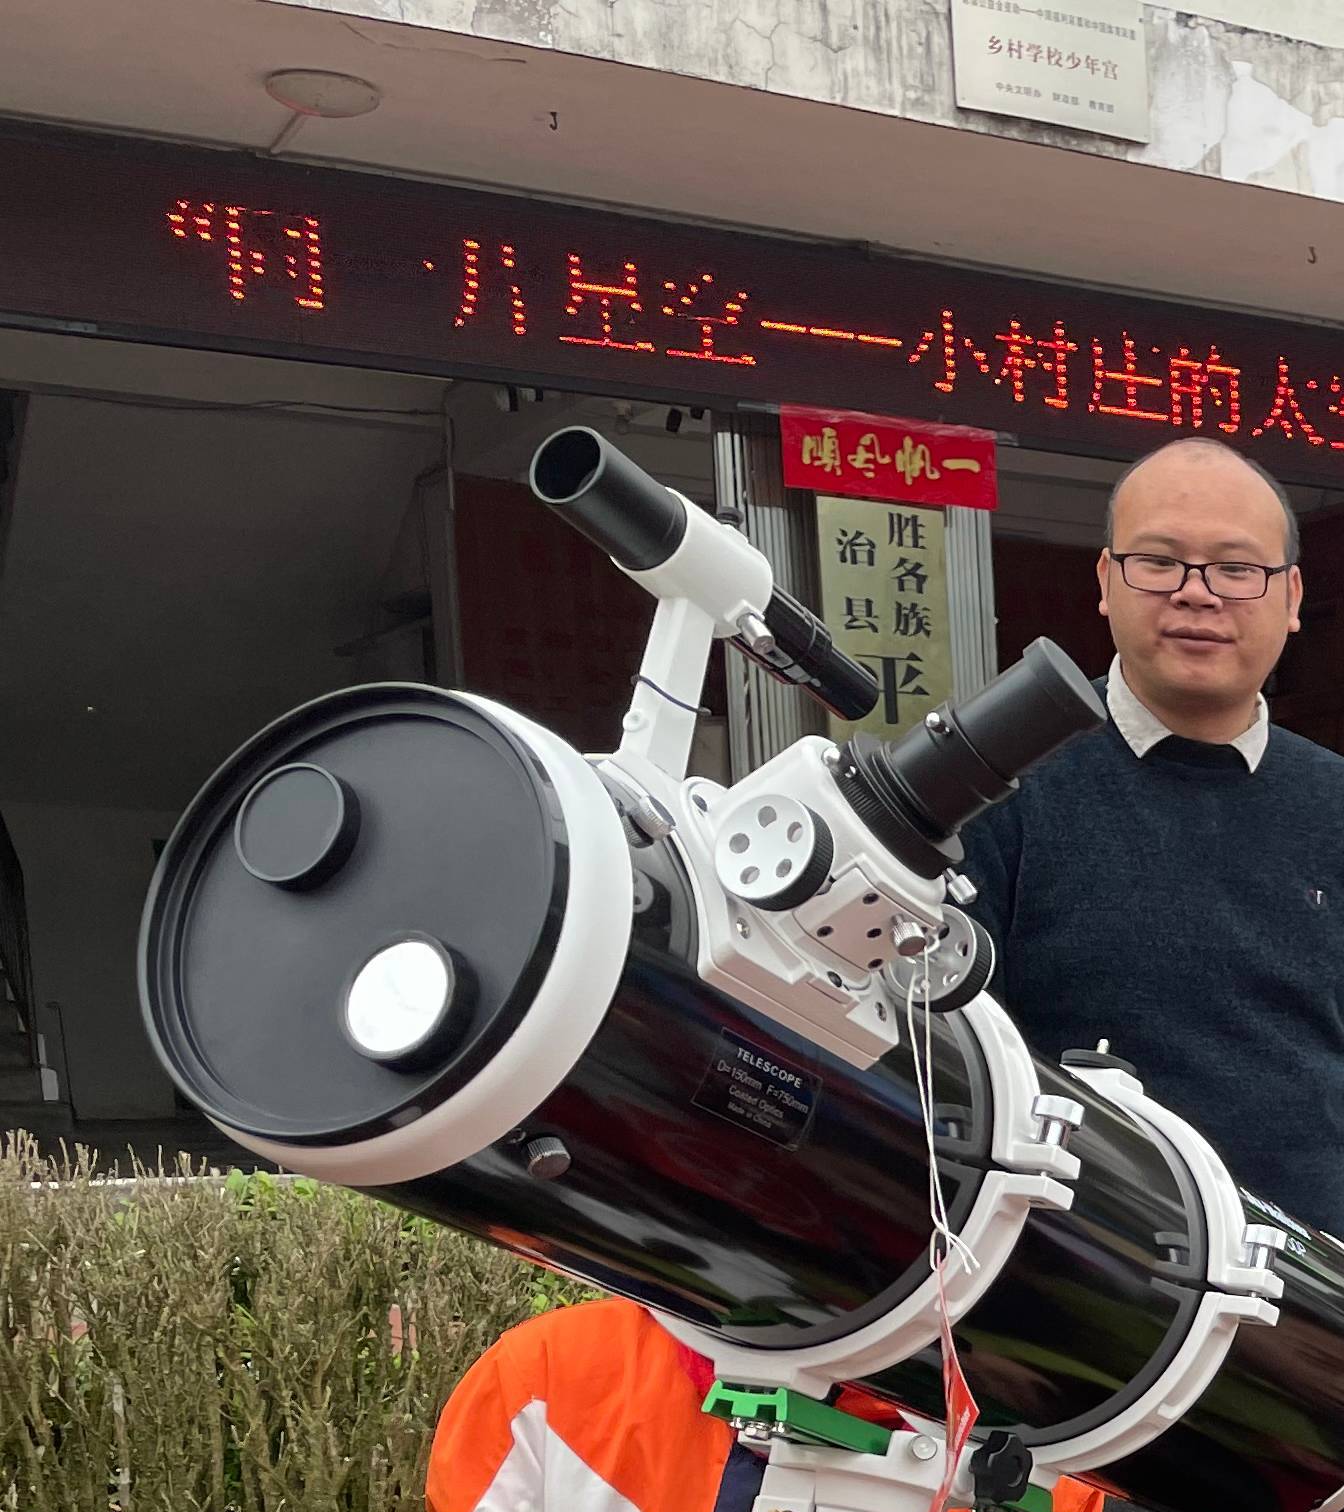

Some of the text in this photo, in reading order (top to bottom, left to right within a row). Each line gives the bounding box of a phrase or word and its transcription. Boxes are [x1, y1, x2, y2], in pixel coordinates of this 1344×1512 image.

[987, 35, 1119, 81] 乡村学校少年宫
[717, 1059, 809, 1114] D=150mm F=750mm
[736, 1047, 803, 1089] TELESCOPE
